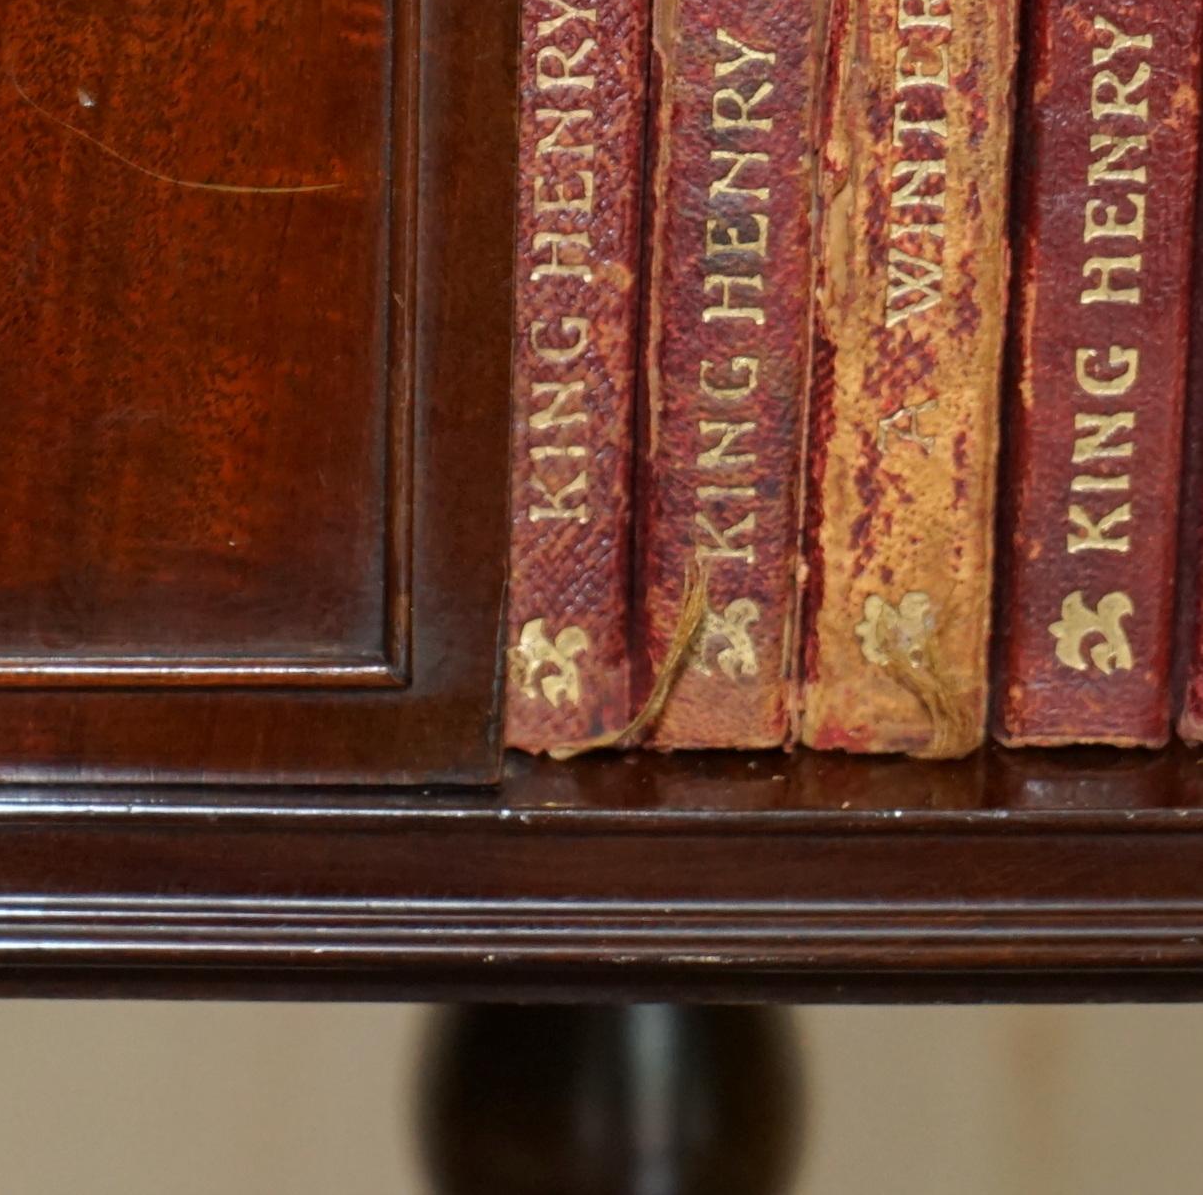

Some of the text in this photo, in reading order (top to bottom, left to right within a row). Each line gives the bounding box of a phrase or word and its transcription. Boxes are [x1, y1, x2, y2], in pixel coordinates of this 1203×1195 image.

[702, 27, 777, 325] HENRY
[1079, 13, 1154, 306] HENRY
[528, 316, 591, 524] KING
[696, 354, 761, 565] KING
[877, 397, 939, 454] A
[1066, 344, 1140, 554] KING
